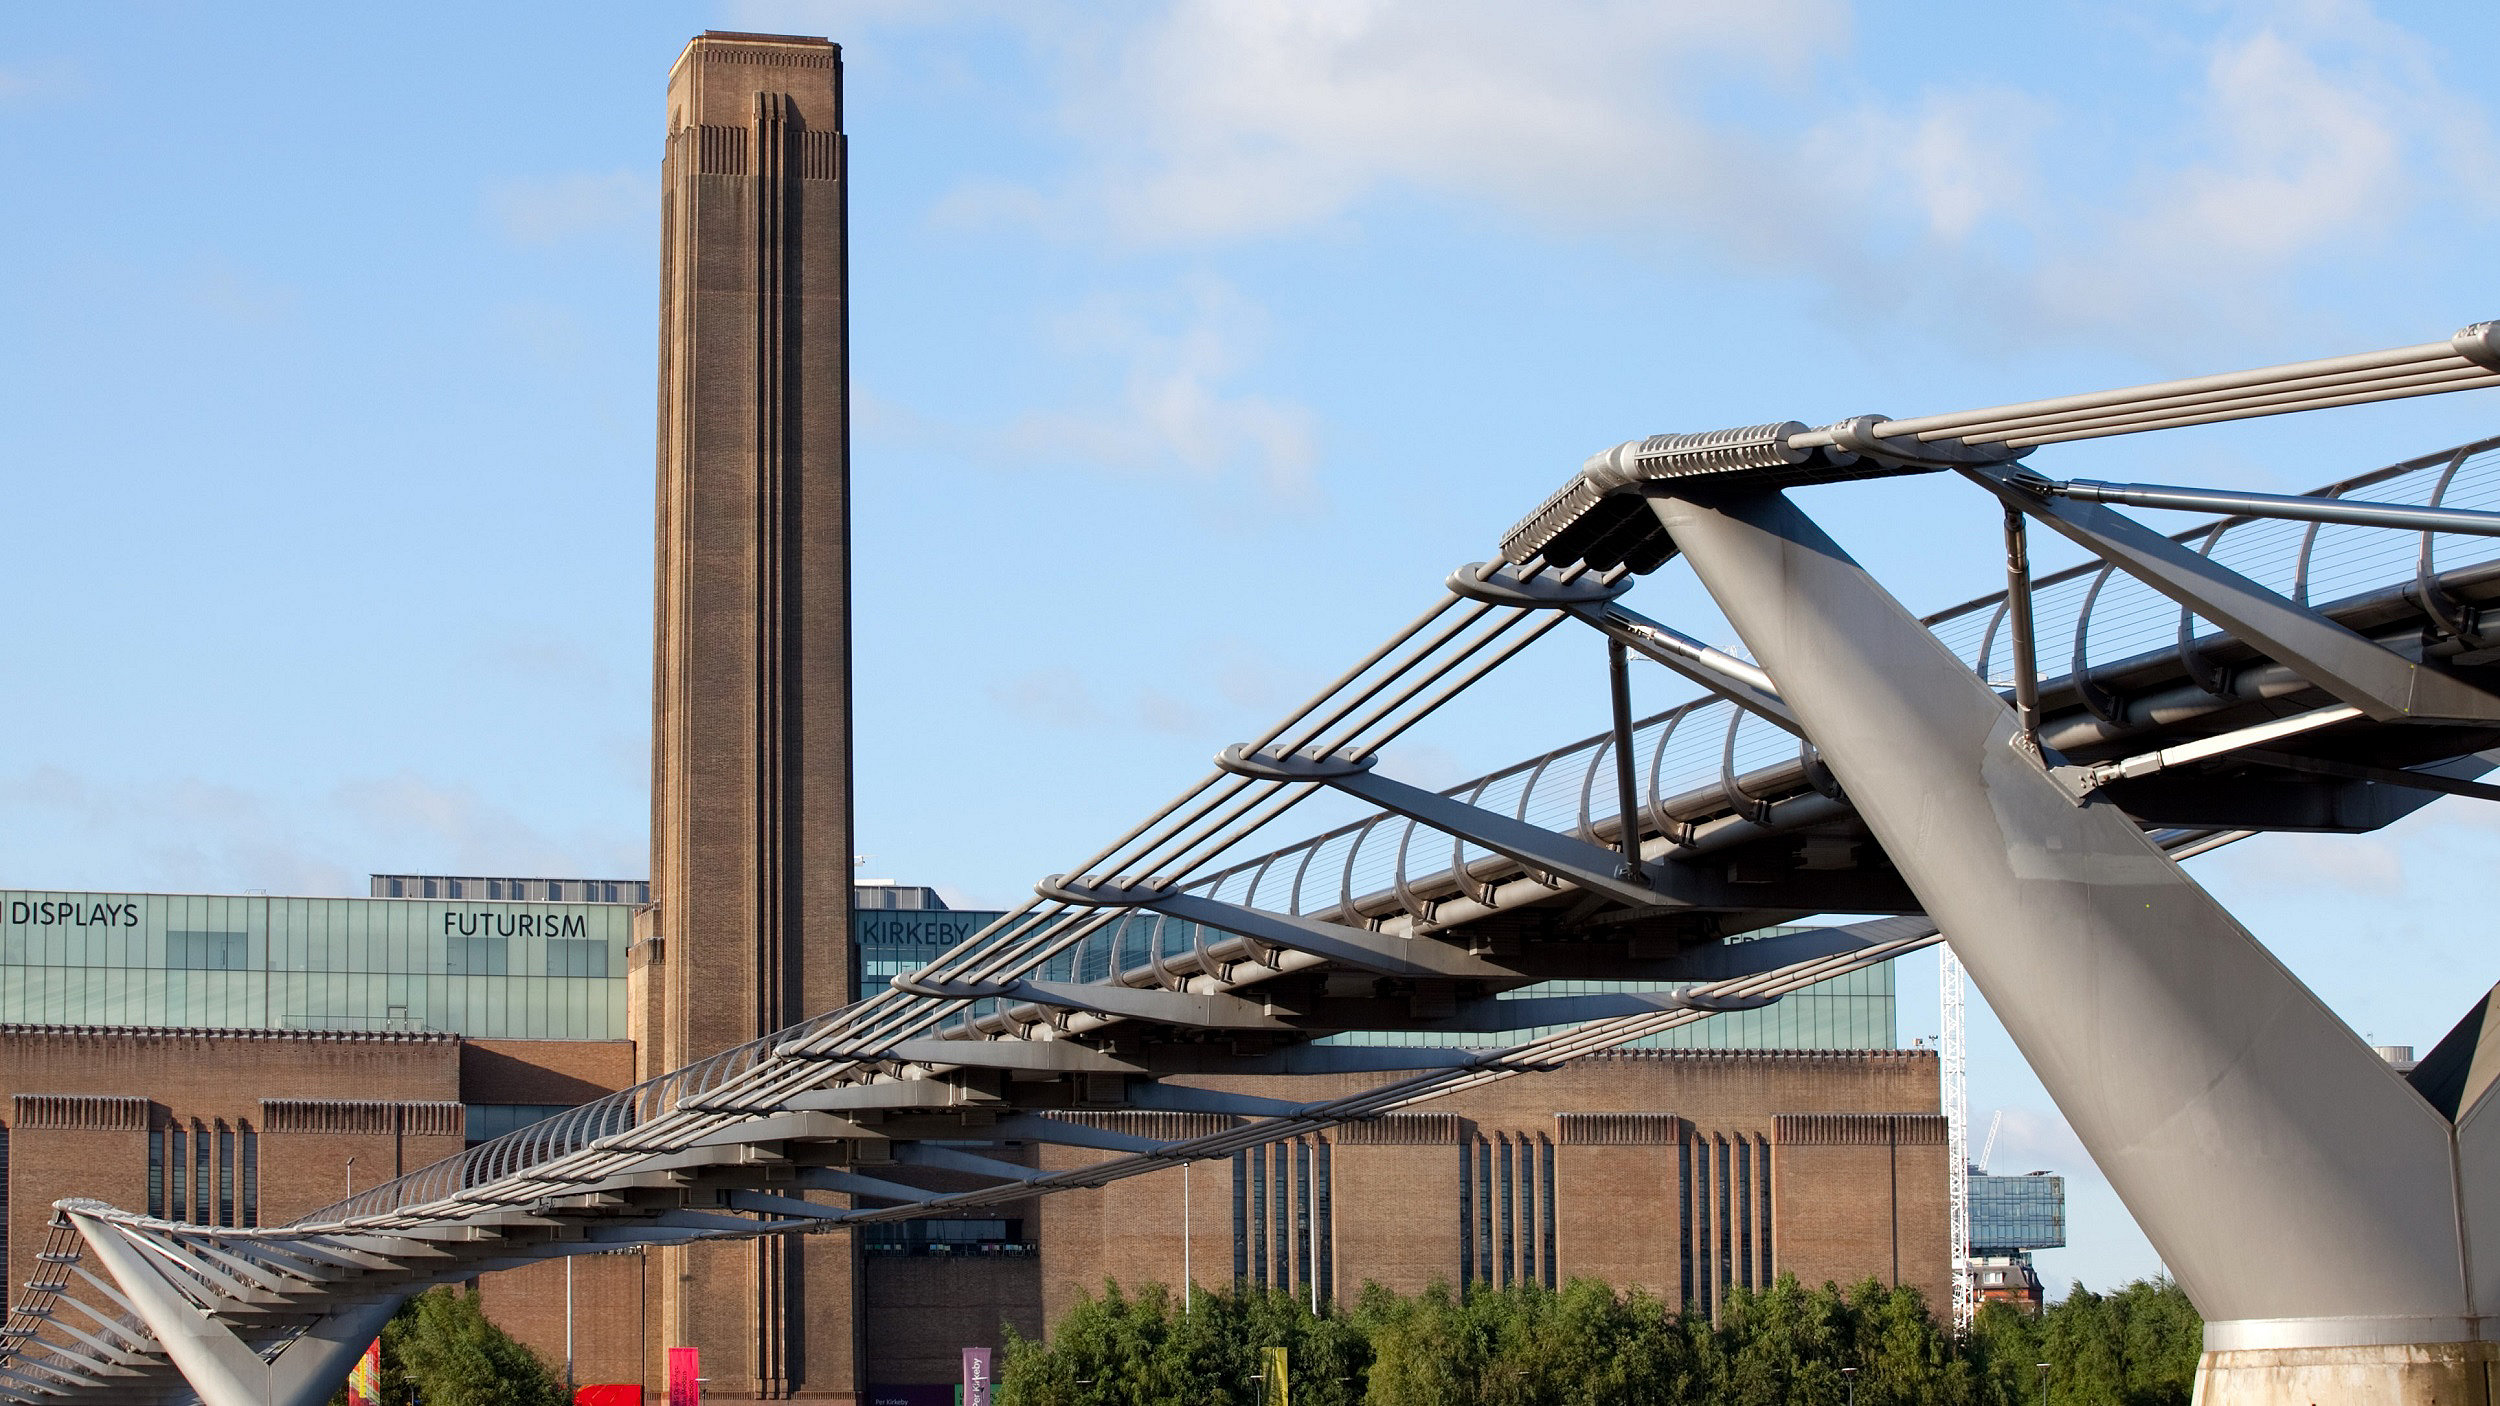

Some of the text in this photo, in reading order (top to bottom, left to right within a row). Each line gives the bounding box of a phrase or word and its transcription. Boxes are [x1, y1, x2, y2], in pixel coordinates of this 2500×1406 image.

[12, 901, 138, 927] DISPLAYS
[444, 912, 586, 938] FUTURISM
[863, 920, 969, 945] KIRKEBY
[971, 1358, 982, 1392] Kirkeby
[886, 1398, 908, 1406] Kirkeby
